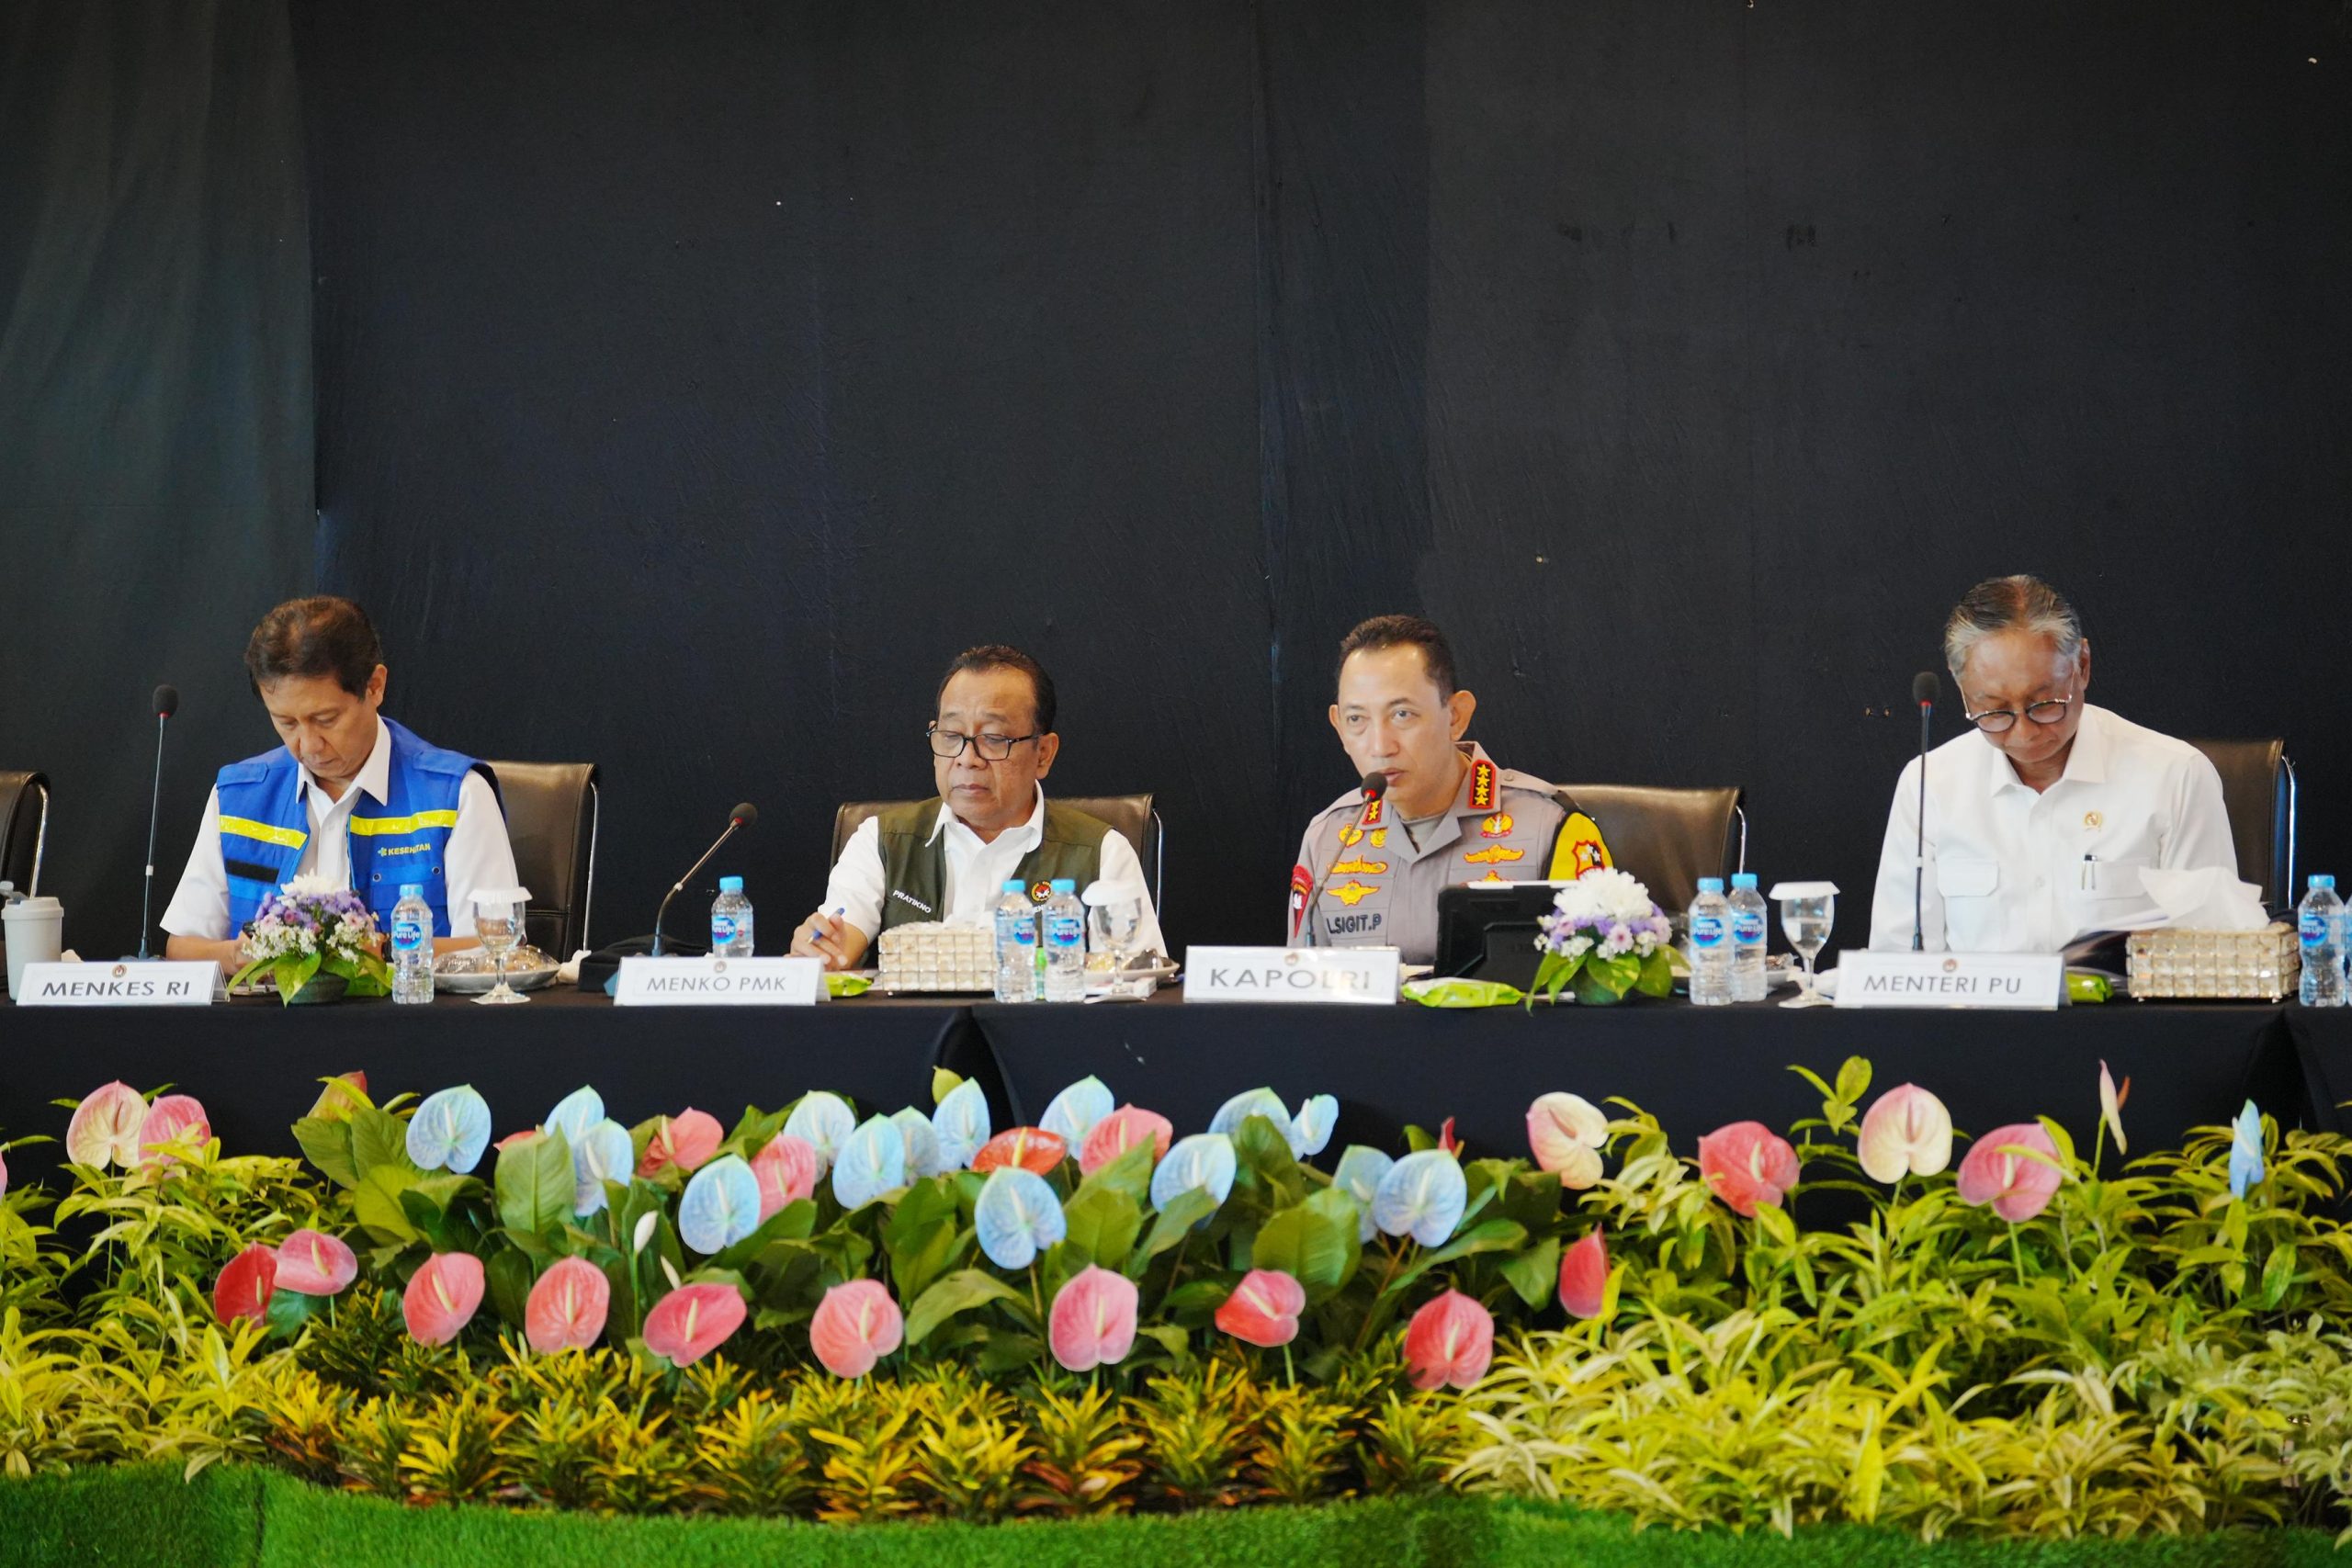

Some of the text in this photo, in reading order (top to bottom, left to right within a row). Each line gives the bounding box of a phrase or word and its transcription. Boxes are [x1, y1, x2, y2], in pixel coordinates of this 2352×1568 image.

[388, 843, 431, 856] KESEHTAN
[892, 889, 932, 913] PRATIKNO
[646, 976, 787, 992] MENKO PMK
[1209, 968, 1371, 990] KAPOLRI
[1863, 975, 2022, 994] MENTERI PU
[41, 980, 190, 997] MENKES RI
